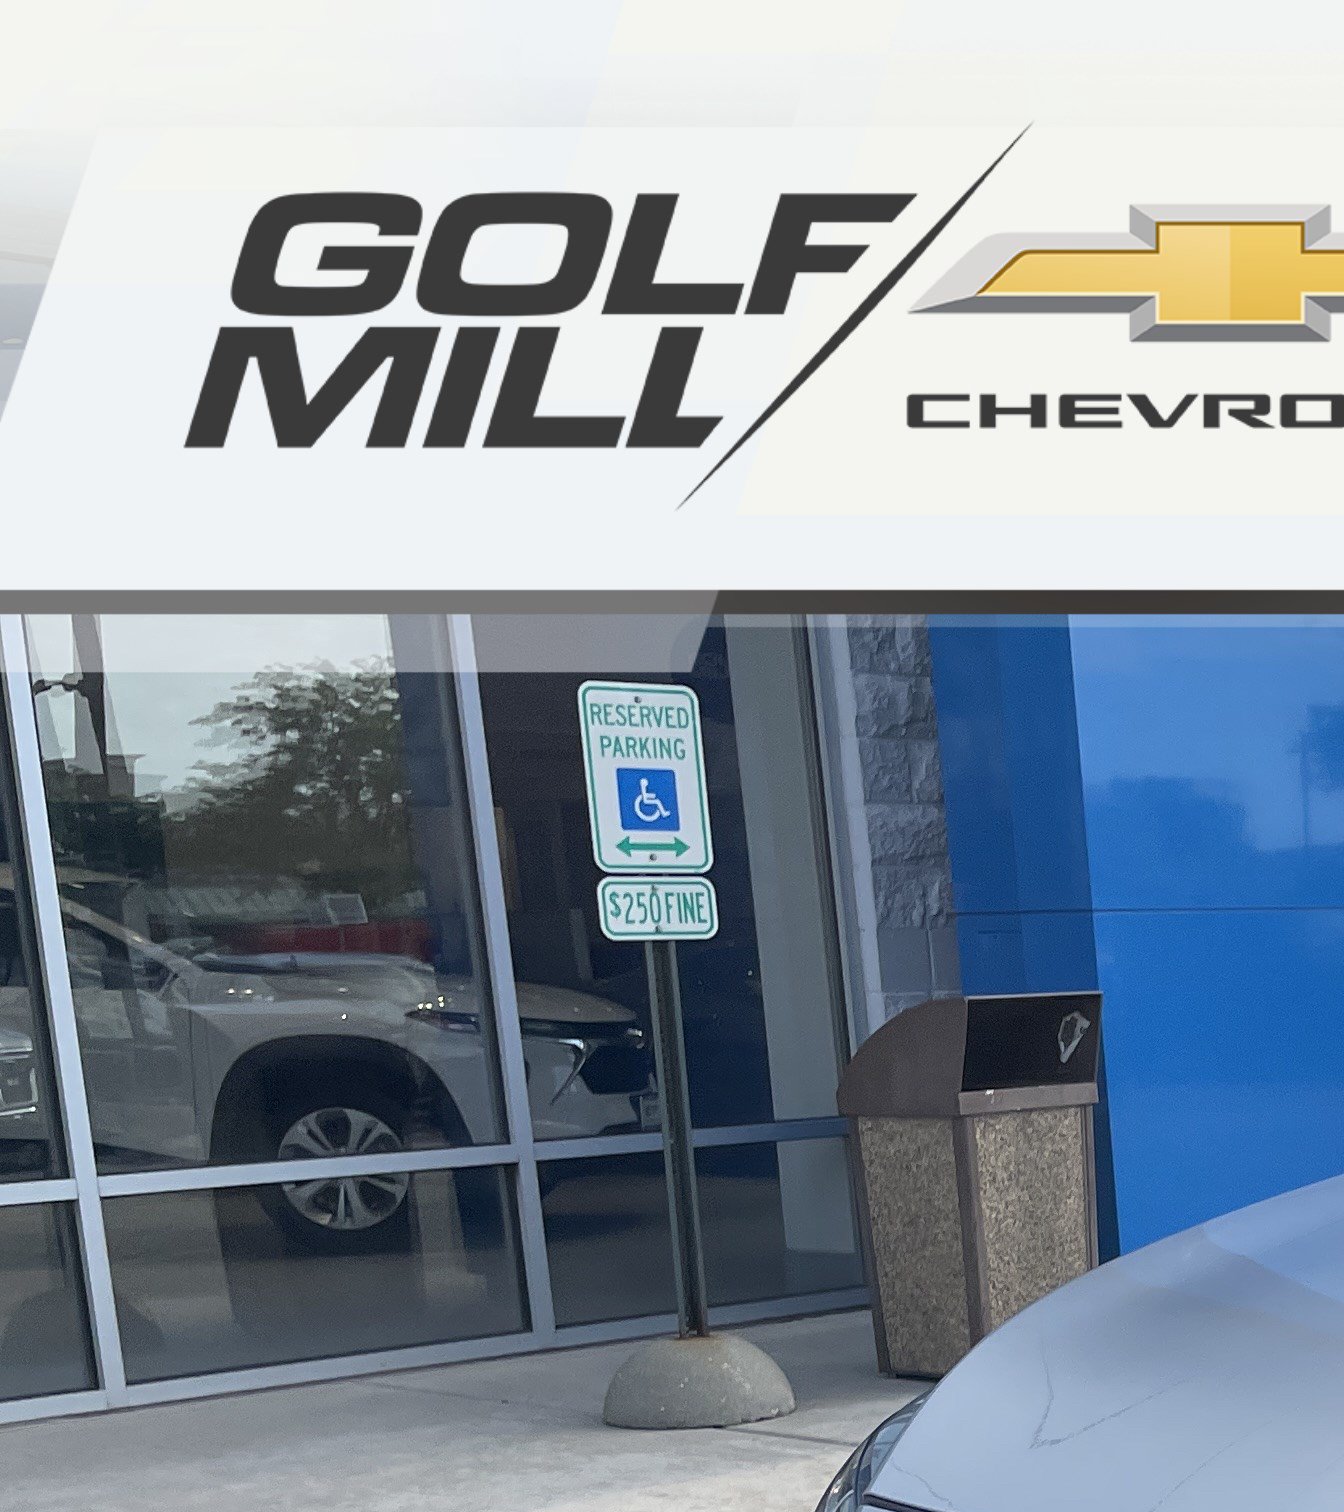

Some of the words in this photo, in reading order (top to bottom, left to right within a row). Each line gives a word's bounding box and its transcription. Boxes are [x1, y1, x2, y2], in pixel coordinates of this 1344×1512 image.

[590, 703, 689, 729] RESERVED
[599, 735, 686, 760] PARKING
[609, 891, 662, 924] $250
[666, 891, 708, 924] FINE
